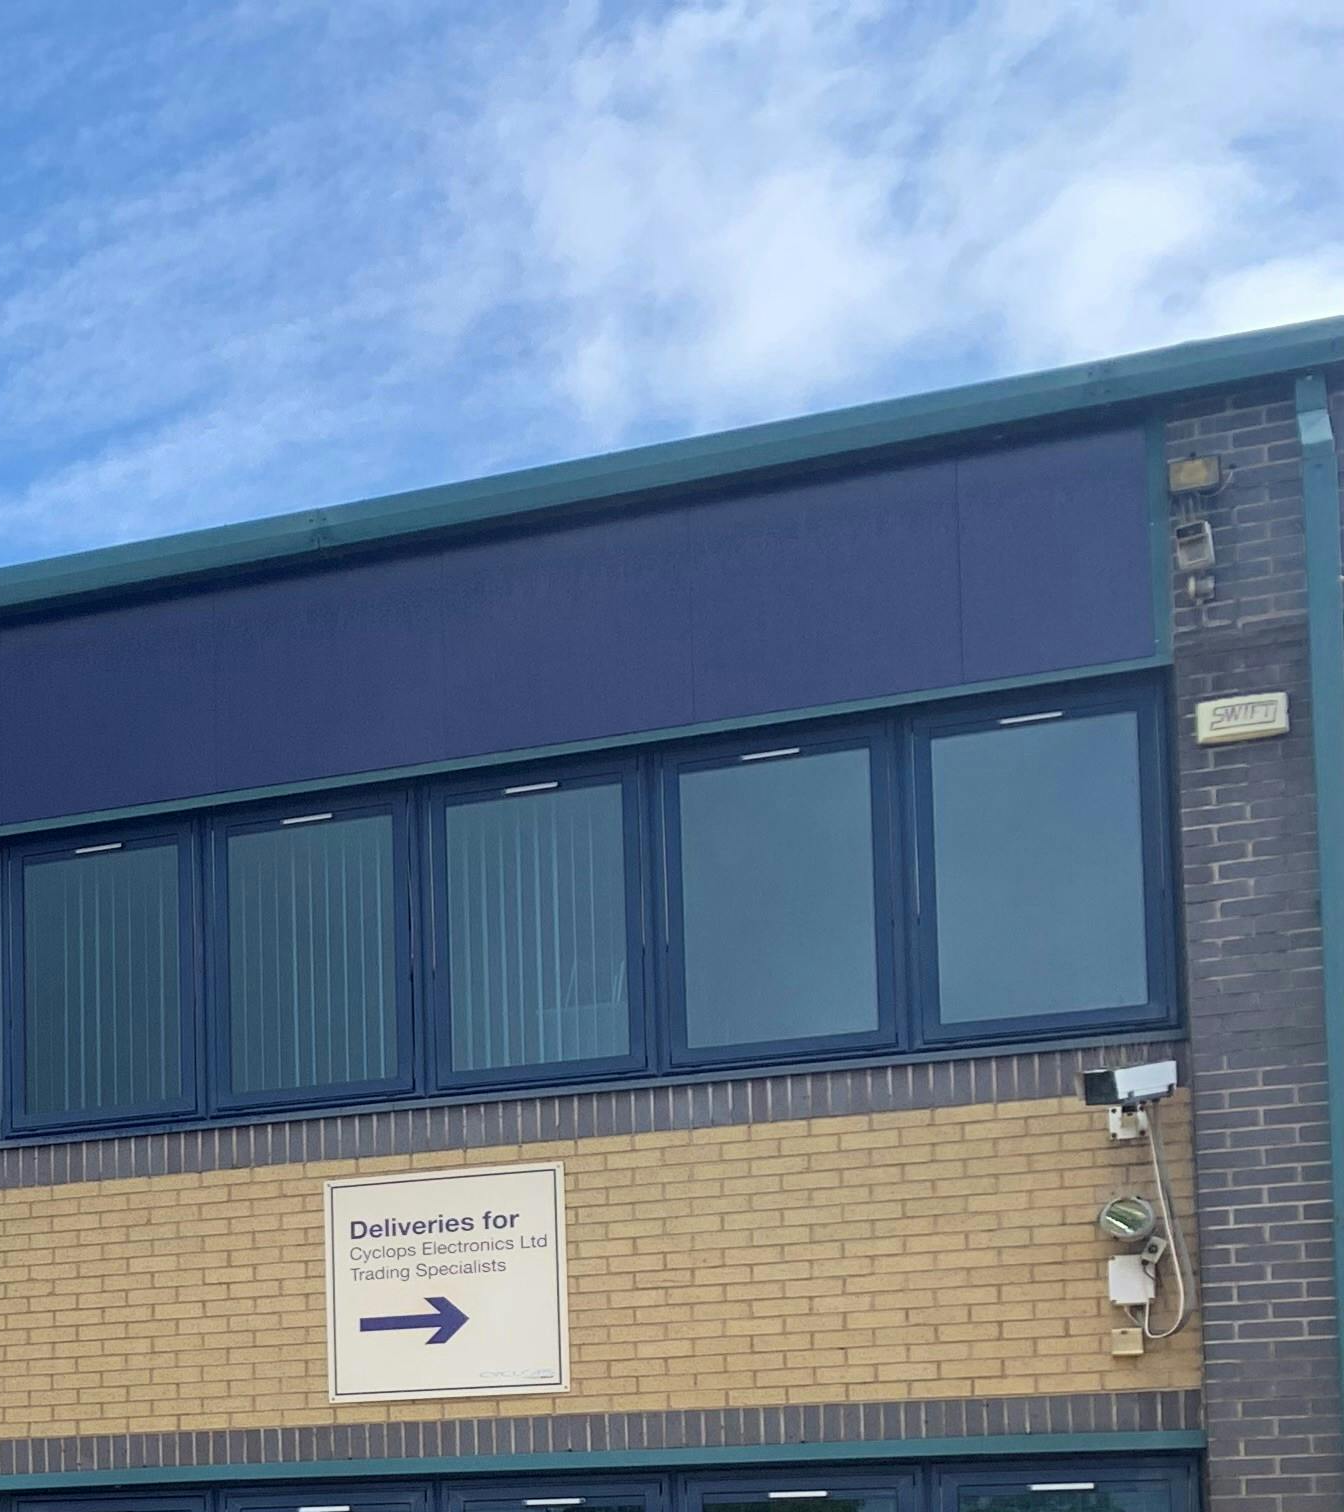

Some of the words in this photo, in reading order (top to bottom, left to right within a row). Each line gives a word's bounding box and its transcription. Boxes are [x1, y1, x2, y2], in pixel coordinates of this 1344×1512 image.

[1210, 699, 1279, 731] SWIFT
[350, 1214, 474, 1240] Deliveries
[482, 1210, 520, 1230] for
[350, 1245, 416, 1264] Cyclops
[422, 1237, 514, 1257] Electronics
[520, 1234, 548, 1249] Ltd
[350, 1265, 410, 1282] Trading
[415, 1259, 507, 1279] Specialists
